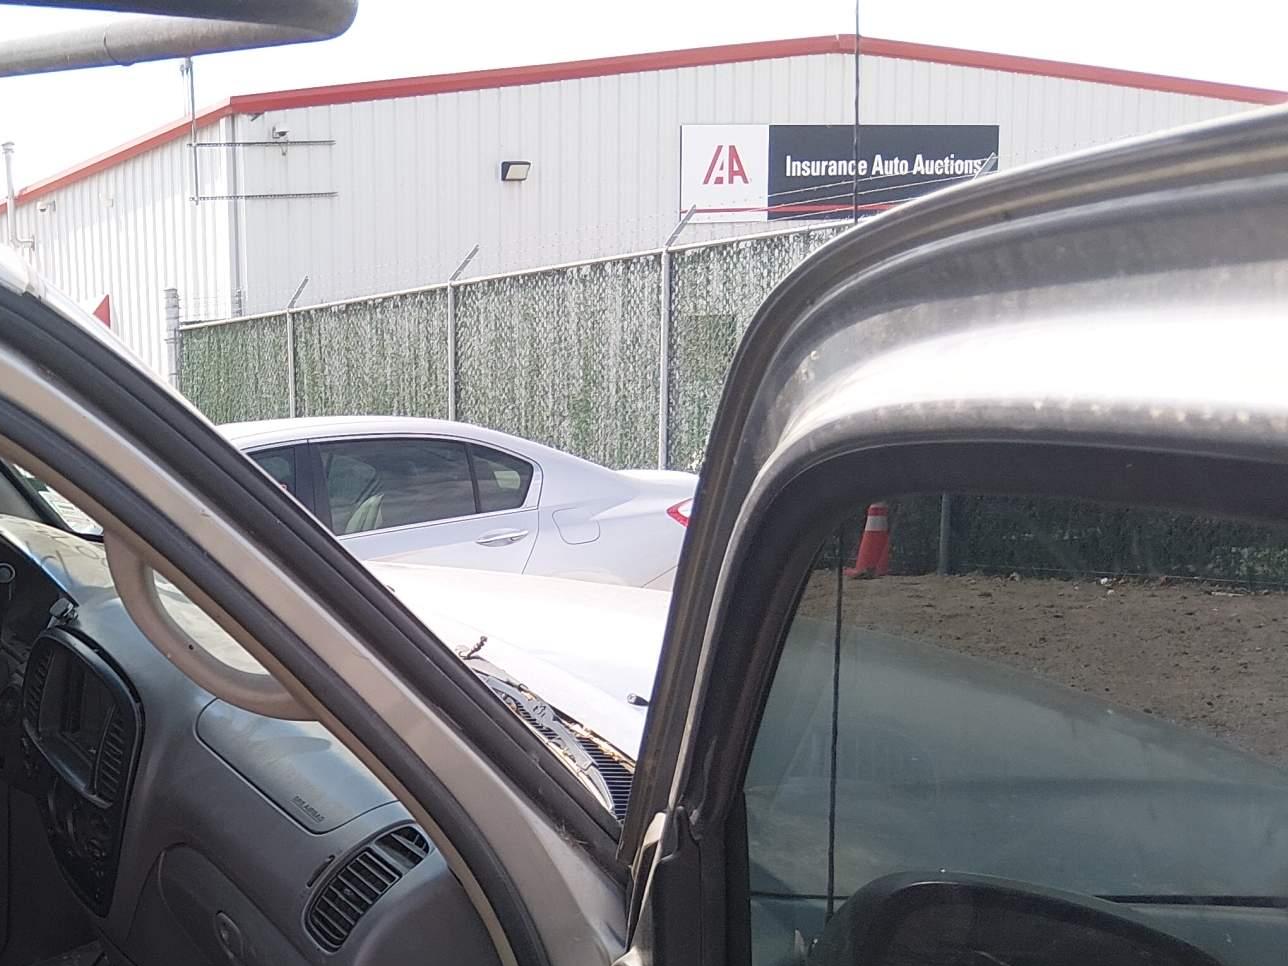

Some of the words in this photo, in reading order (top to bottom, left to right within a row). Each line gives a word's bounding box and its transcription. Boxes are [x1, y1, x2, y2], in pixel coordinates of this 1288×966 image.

[785, 155, 867, 177] Insurance
[871, 154, 909, 176] Auto
[912, 153, 982, 176] Auctions
